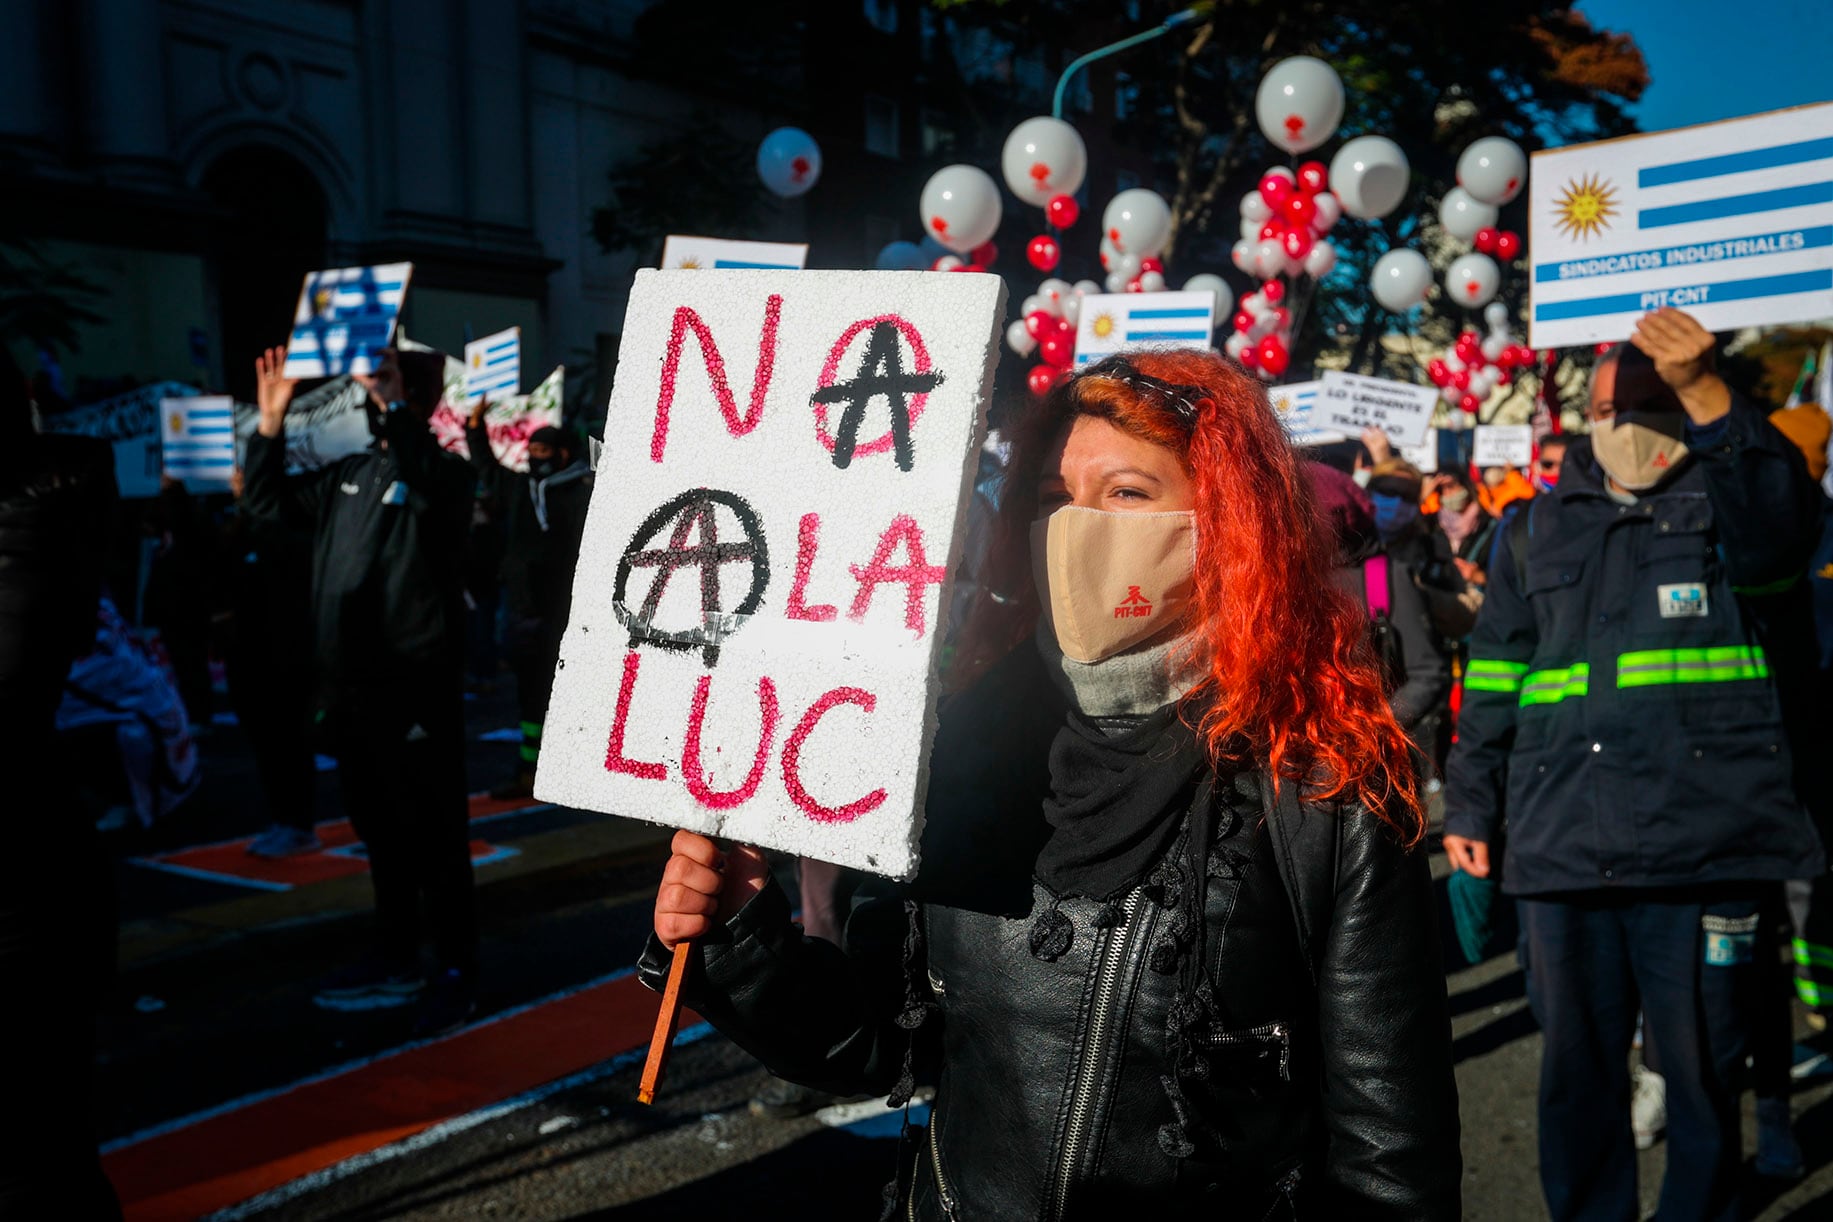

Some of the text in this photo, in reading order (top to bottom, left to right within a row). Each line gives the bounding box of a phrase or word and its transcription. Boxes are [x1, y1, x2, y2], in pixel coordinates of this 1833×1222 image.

[1558, 232, 1805, 279] SINDICATOS INDUSTRIALES
[1640, 286, 1711, 309] PIT-CNT
[785, 512, 947, 640] LA
[1114, 605, 1153, 619] PIT-CNT
[603, 649, 888, 826] LUC
